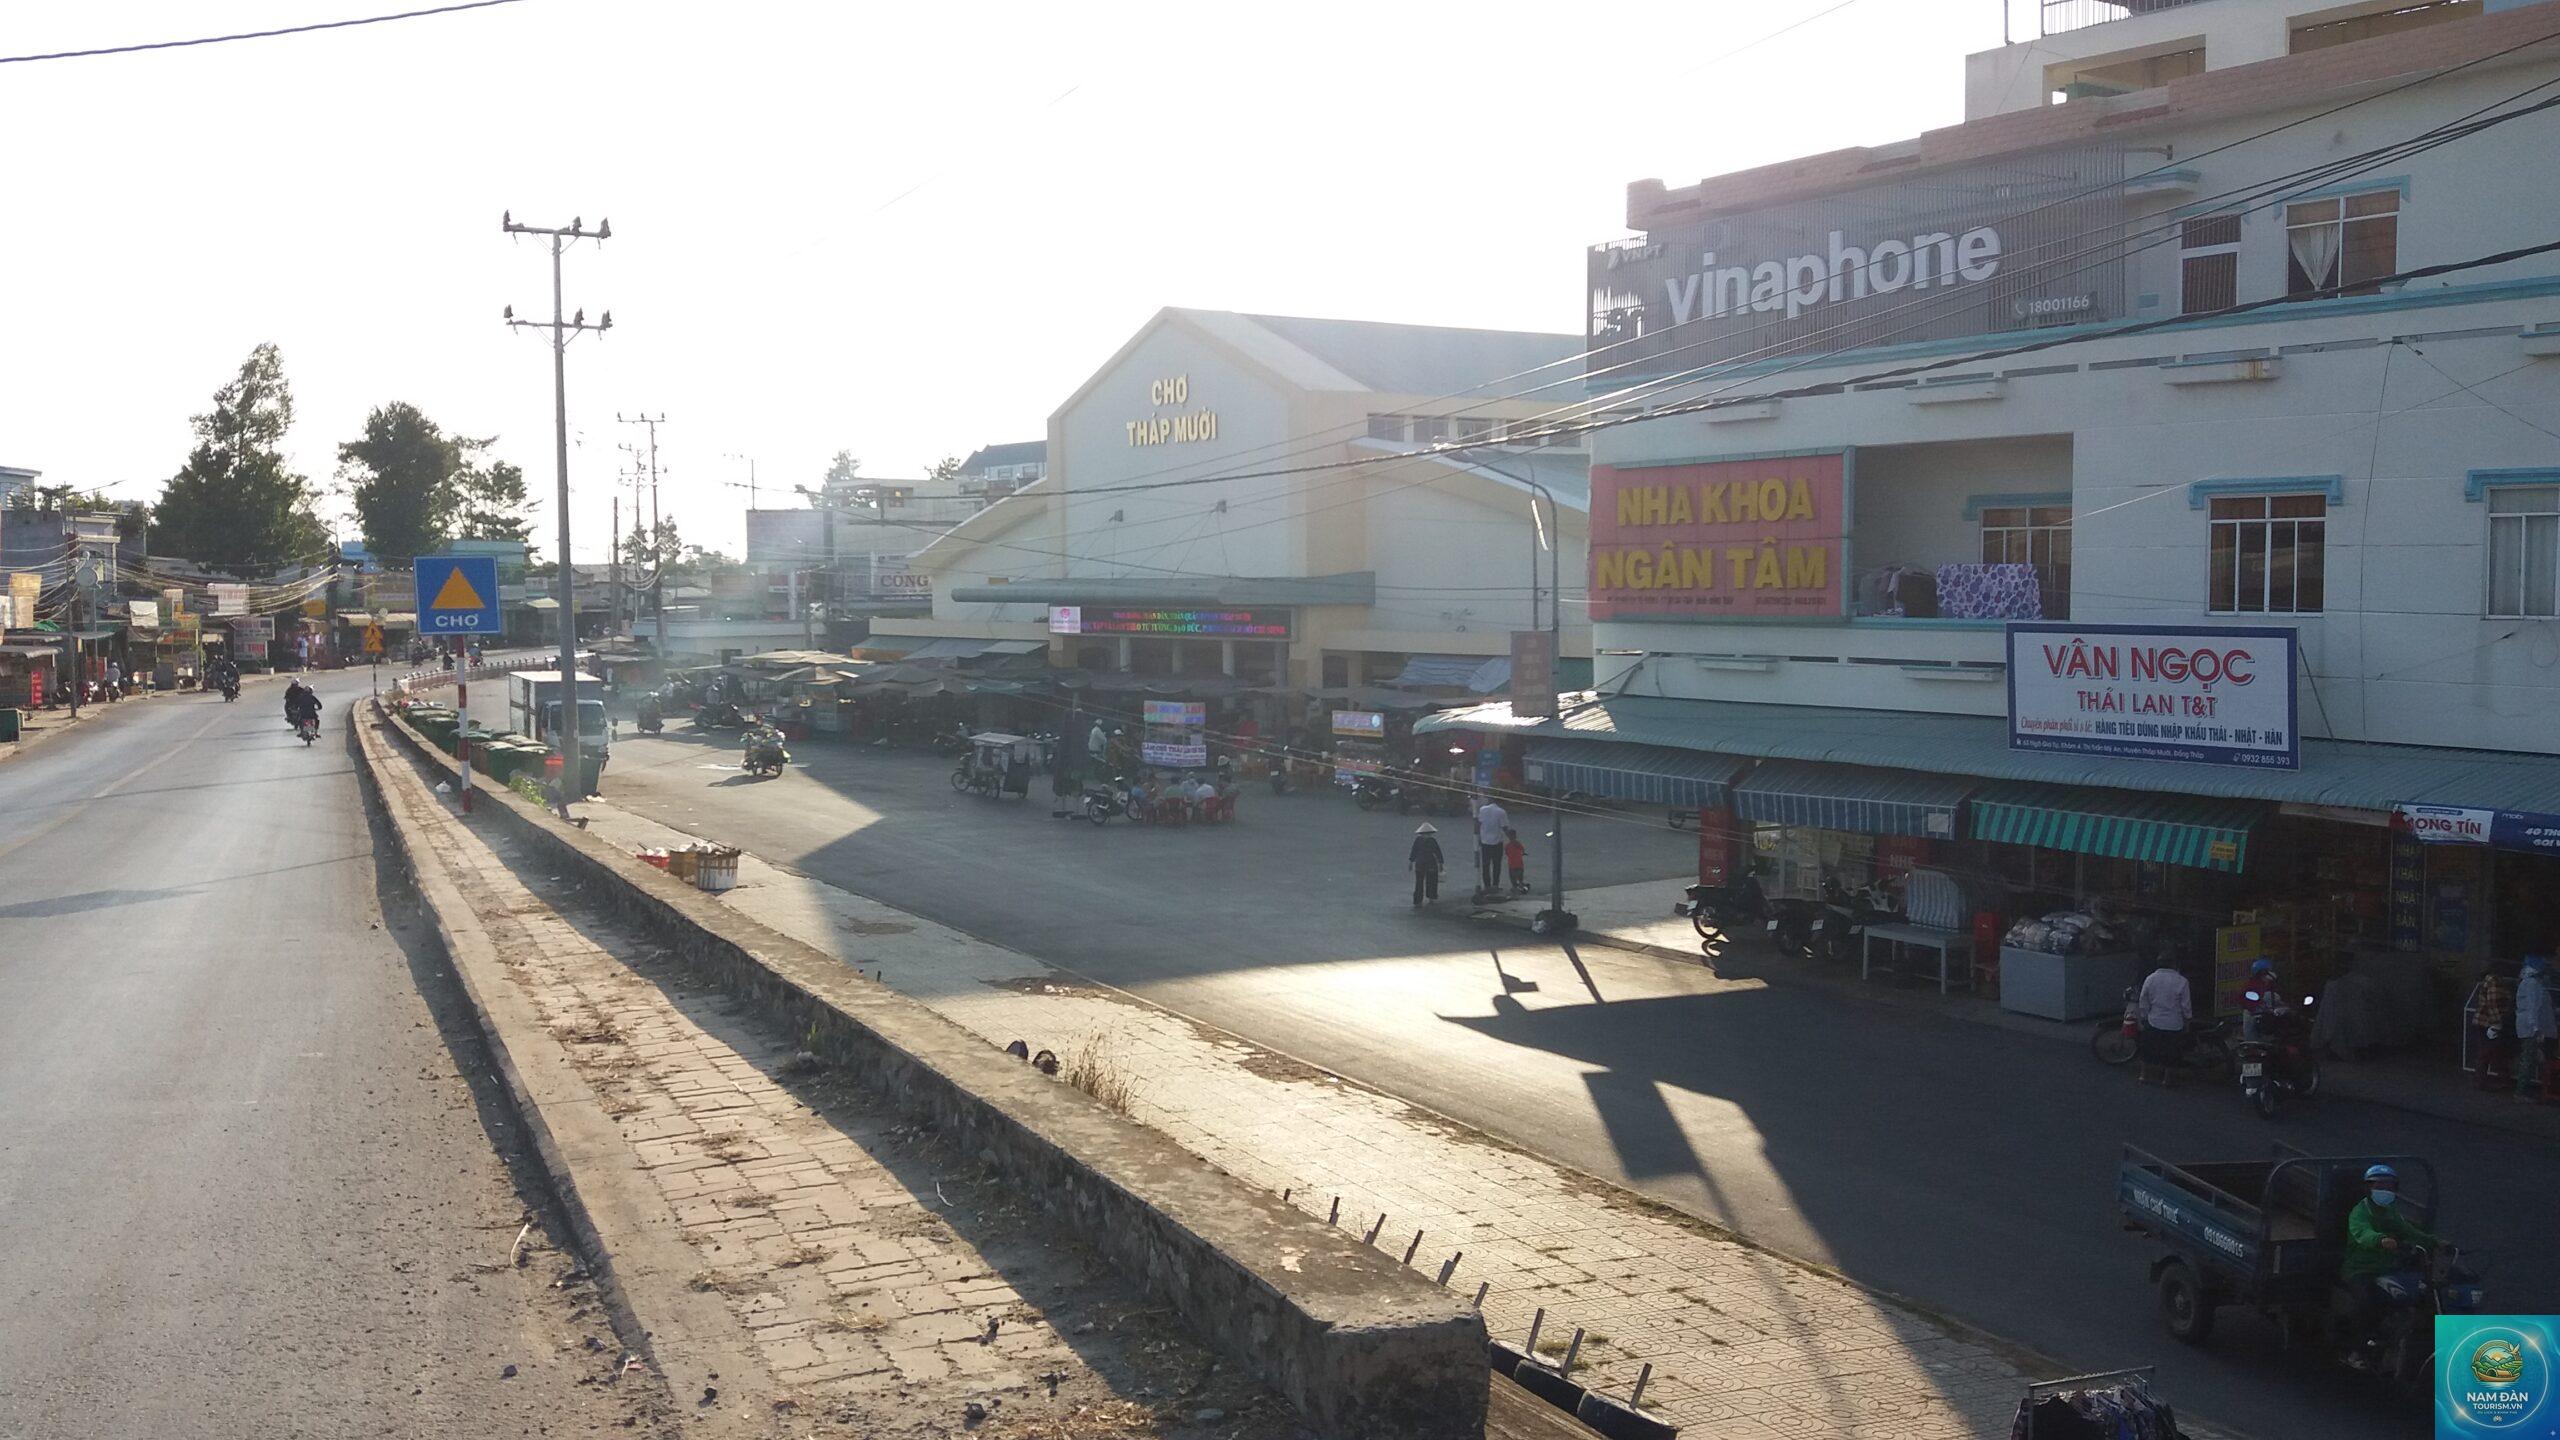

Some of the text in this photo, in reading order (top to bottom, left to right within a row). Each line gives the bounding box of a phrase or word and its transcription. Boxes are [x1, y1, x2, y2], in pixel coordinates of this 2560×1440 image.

[1622, 243, 1663, 262] VNPT
[1665, 226, 2001, 326] vinaphone
[2029, 295, 2089, 314] 18001166
[1151, 371, 1188, 408] CHỢ
[1126, 405, 1217, 447] THÁP MƯỜI
[1617, 477, 1814, 526] NHA KHOA
[1596, 535, 1827, 589] NGÂN TÂM
[435, 613, 479, 630] CHỢ
[2042, 637, 2255, 692] VÂN NGỌC
[2077, 687, 2217, 719] THÁI LAN T&T
[2095, 718, 2117, 735] HÀNG
[2118, 720, 2135, 736] TIÊU
[2264, 730, 2283, 745] HÀN
[2241, 754, 2260, 764] 0932
[2276, 756, 2290, 765] 393
[2457, 818, 2482, 835] TÍN
